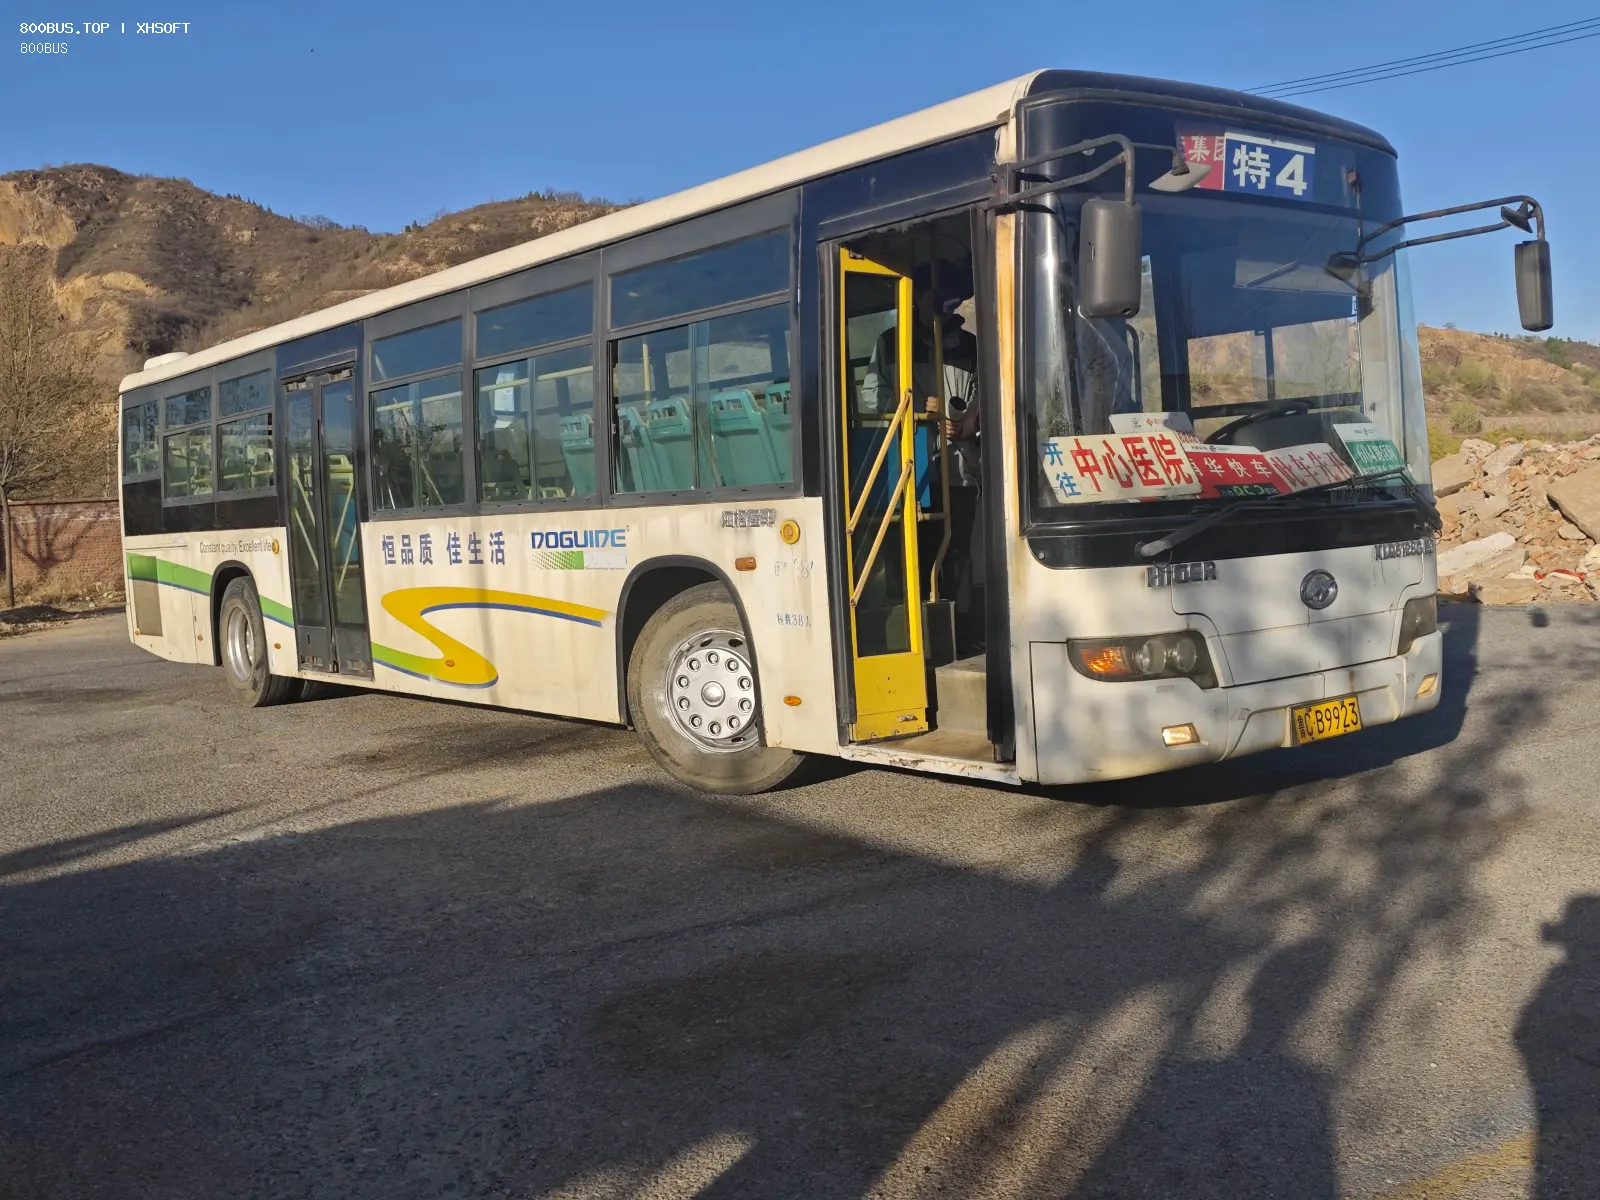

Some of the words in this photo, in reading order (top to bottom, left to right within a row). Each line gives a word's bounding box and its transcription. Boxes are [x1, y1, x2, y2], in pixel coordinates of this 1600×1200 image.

[1232, 144, 1308, 196] 特4
[1043, 442, 1082, 498] 开往
[1070, 433, 1194, 493] 中心医院
[382, 532, 434, 566] 恒品质
[446, 531, 506, 565] 佳生活
